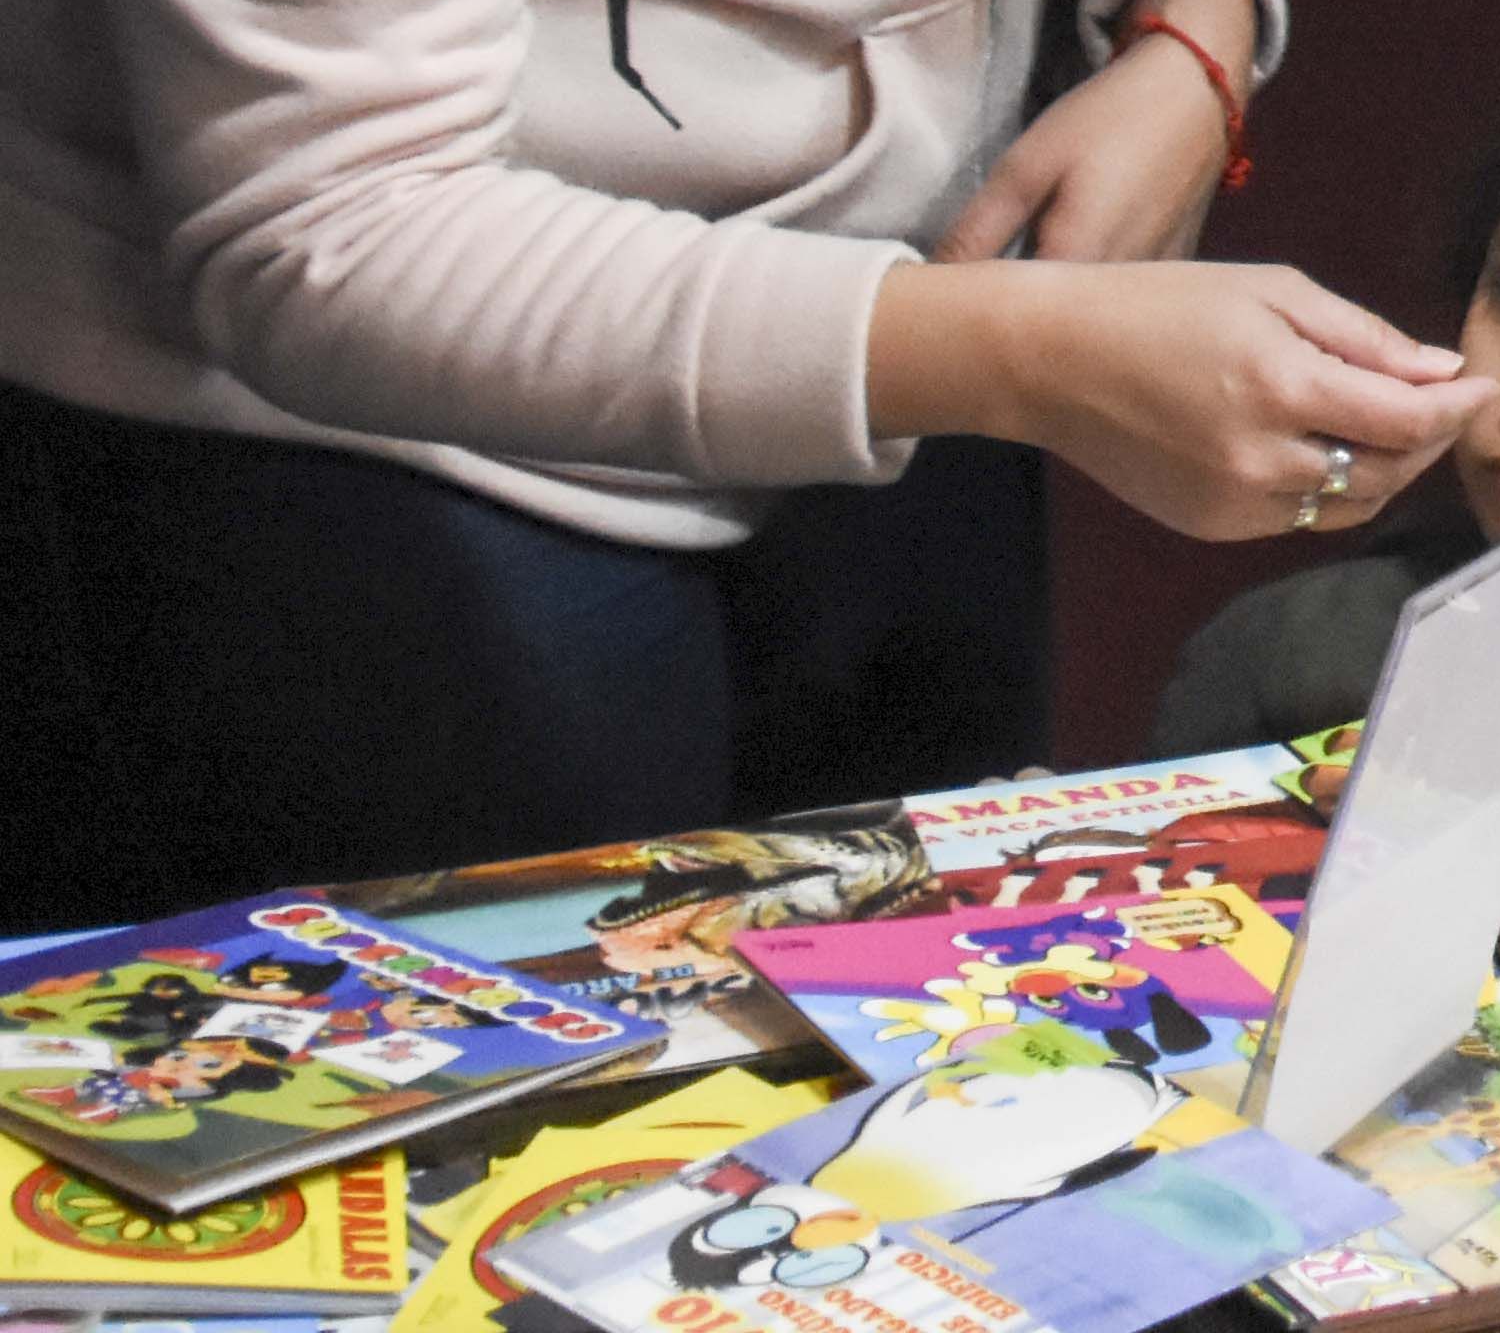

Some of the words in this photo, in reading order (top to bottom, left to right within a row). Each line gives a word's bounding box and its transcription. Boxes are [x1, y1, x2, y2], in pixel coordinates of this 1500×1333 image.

[905, 772, 1220, 829] AMANDA
[959, 817, 1056, 839] VACA
[1068, 788, 1249, 824] ESTRELLA
[339, 1160, 393, 1282] ANDALAS
[895, 1251, 1023, 1323] EDIFICIO
